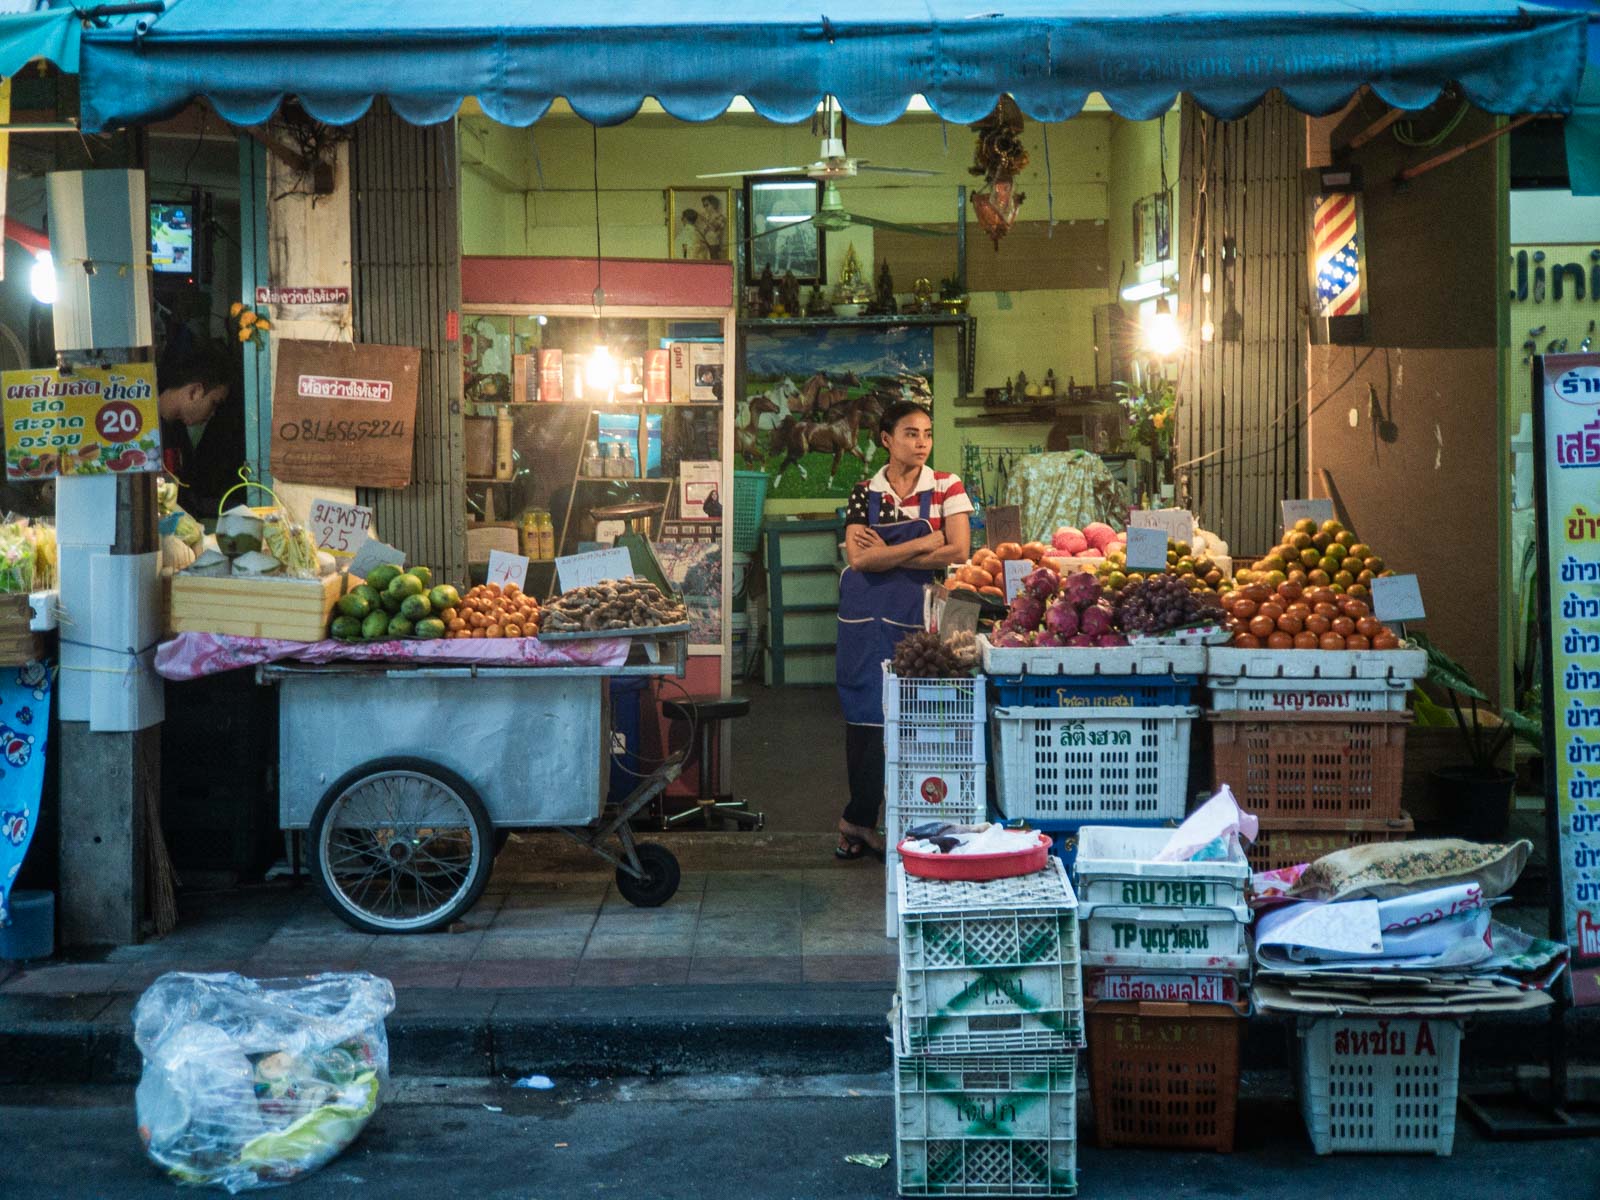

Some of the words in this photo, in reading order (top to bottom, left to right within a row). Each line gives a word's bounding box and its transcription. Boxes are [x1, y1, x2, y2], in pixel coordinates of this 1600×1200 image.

[1509, 249, 1600, 304] lini
[301, 379, 389, 400] ห้องว่างให้เช่า
[32, 400, 64, 413] สด
[14, 416, 84, 430] สะอาด
[20, 431, 81, 447] อร่อย
[319, 526, 353, 551] 25
[1562, 556, 1600, 582] ข้าว
[1111, 922, 1137, 949] TP
[1414, 1020, 1437, 1055] A
